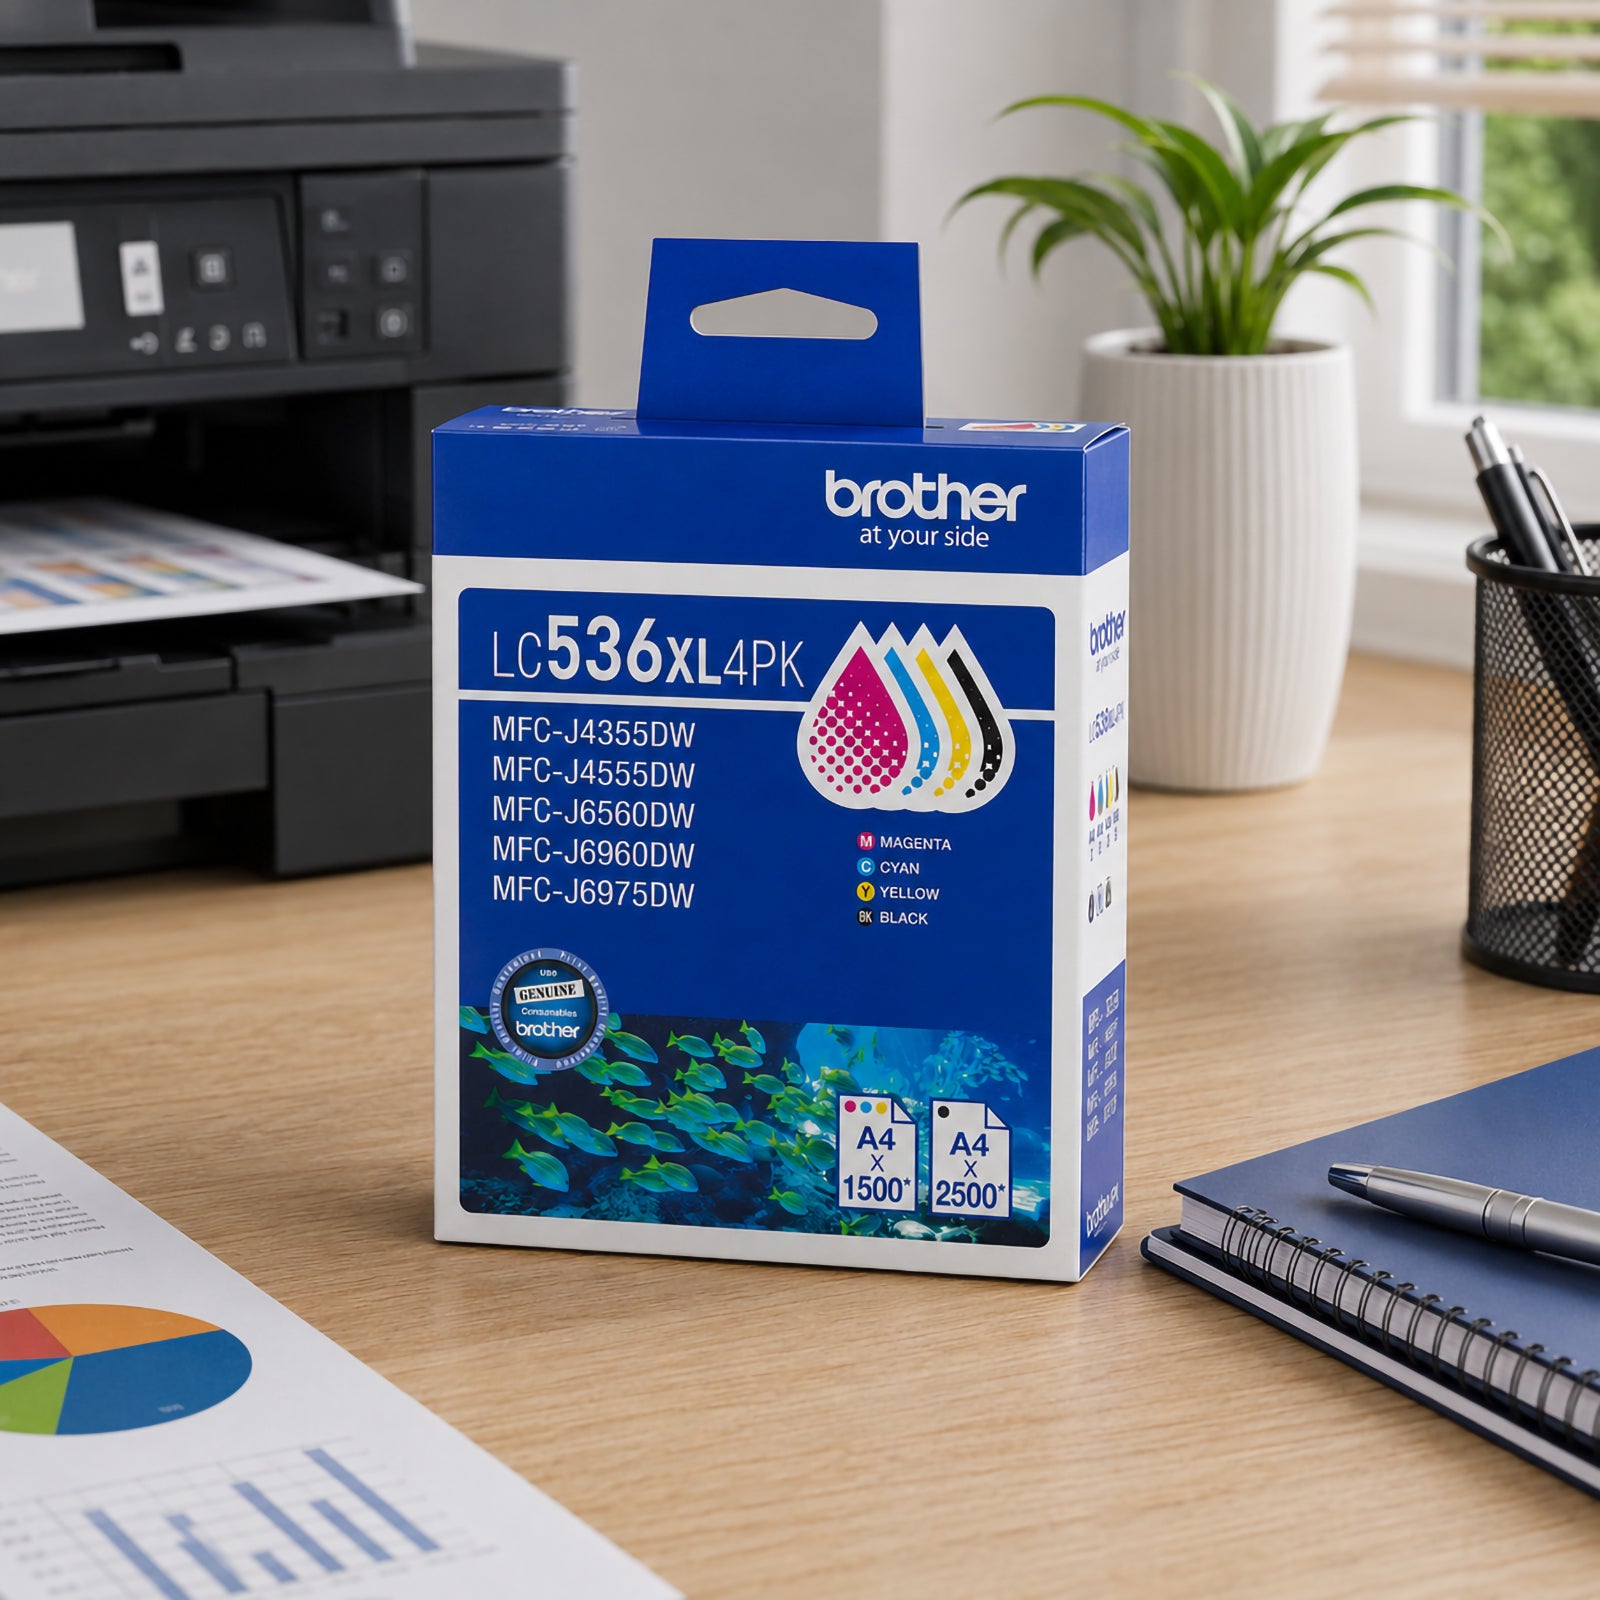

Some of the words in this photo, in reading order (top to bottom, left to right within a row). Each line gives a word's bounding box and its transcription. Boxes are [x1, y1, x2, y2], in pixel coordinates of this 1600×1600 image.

[825, 469, 1027, 522] brother
[859, 525, 882, 545] at
[887, 528, 939, 550] your
[944, 525, 990, 548] side
[493, 614, 805, 688] LC536XL4PK
[493, 715, 696, 748] MFC-J4355DW
[493, 755, 696, 789] MFC-J4555DW
[493, 795, 696, 829] MFC-J6560DW
[493, 835, 696, 869] MFC-J6960DW
[860, 835, 873, 848] M
[880, 835, 952, 851] MAGENTA
[861, 860, 872, 873] C
[880, 861, 920, 875] CYAN
[493, 875, 696, 909] MFC-J6975DW
[861, 885, 871, 898] Y
[880, 886, 940, 901] YELLOW
[859, 910, 873, 923] BK
[880, 911, 928, 925] BLACK
[519, 983, 577, 1001] GENUINE
[515, 1020, 581, 1038] brother
[856, 1125, 896, 1151] A4
[949, 1131, 990, 1157] A4
